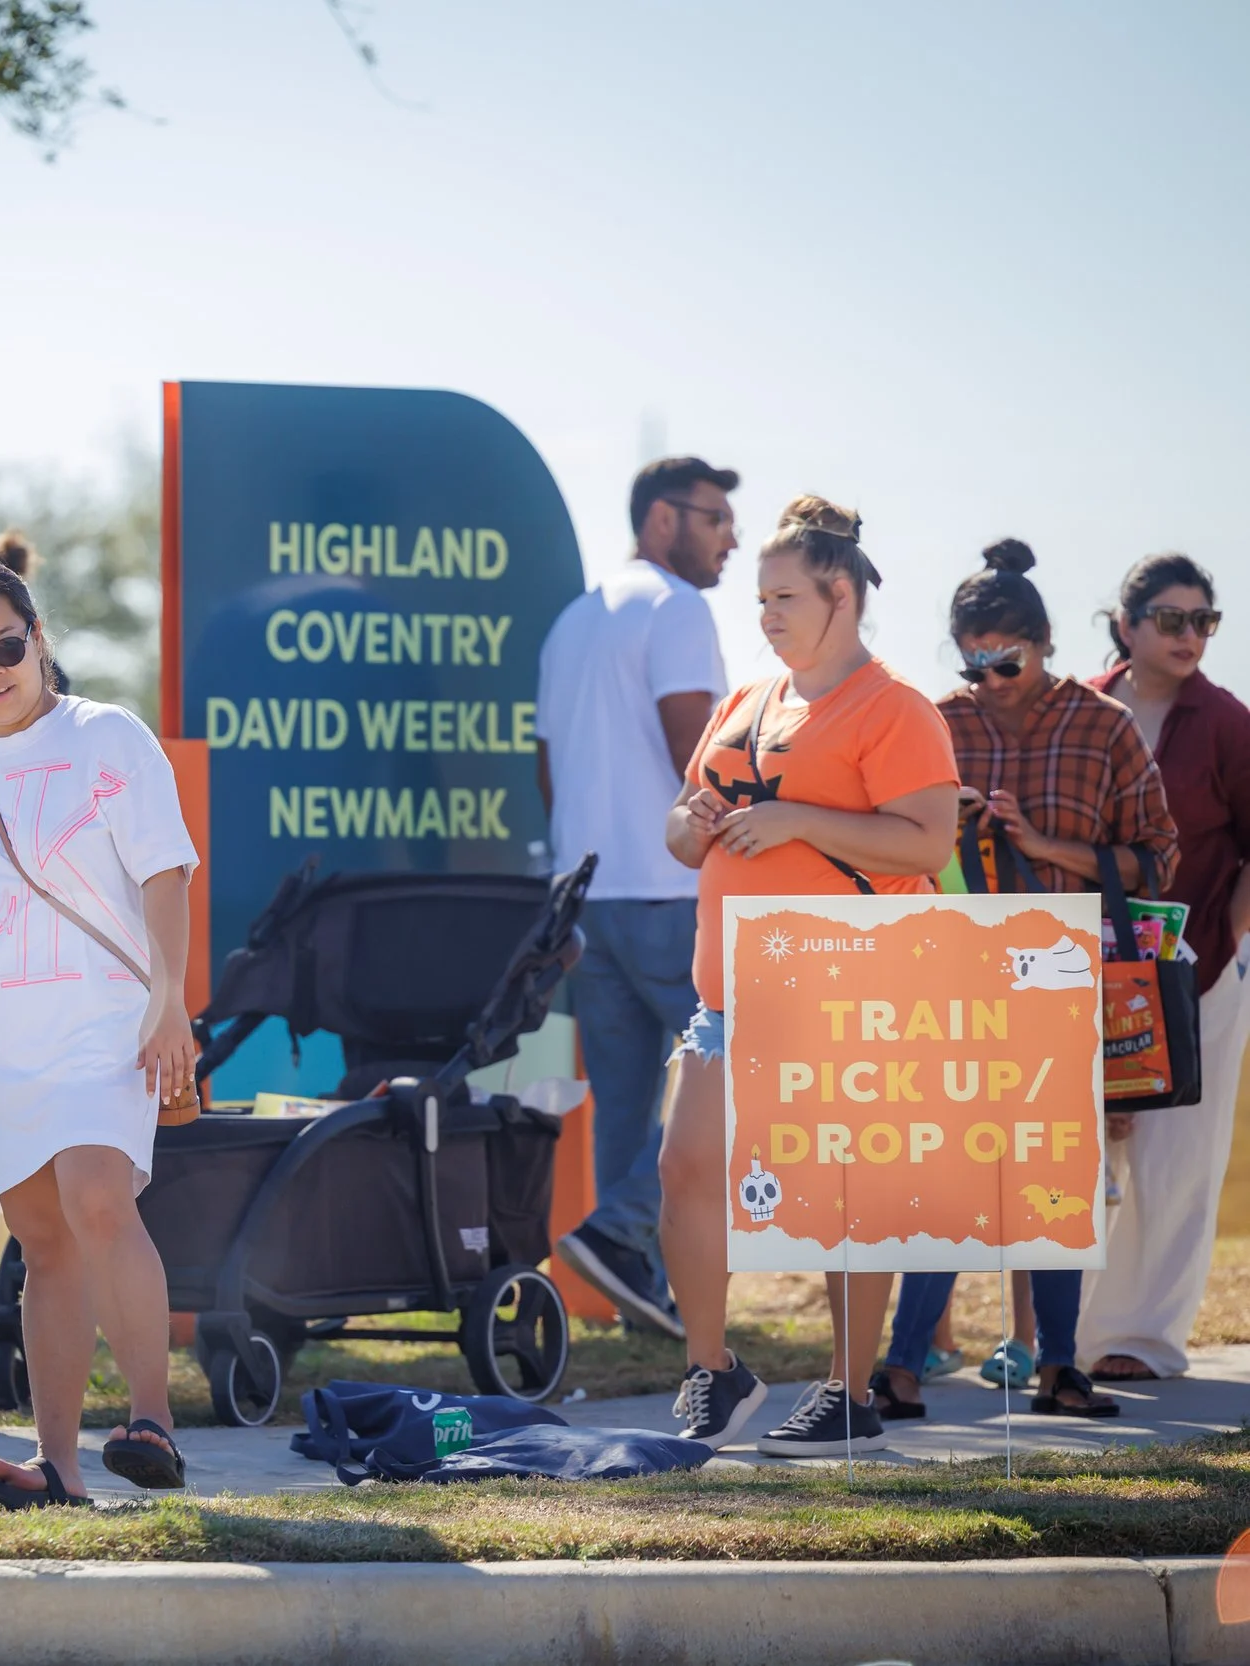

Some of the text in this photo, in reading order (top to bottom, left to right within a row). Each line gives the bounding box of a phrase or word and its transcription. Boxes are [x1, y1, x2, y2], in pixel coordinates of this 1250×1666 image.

[269, 522, 509, 580] HIGHLAND
[265, 609, 512, 666] COVENTRY
[206, 698, 538, 753] DAVID WEEKLE
[269, 787, 511, 840] NEWMARK
[799, 937, 877, 953] JUBILEE
[820, 999, 1008, 1042] TRAIN
[1104, 1010, 1153, 1038] AUNTS
[1105, 1032, 1152, 1057] TACULAR
[779, 1058, 1054, 1103] PICK UP/
[770, 1121, 1082, 1165] DROP OFF
[433, 1420, 472, 1447] prit
